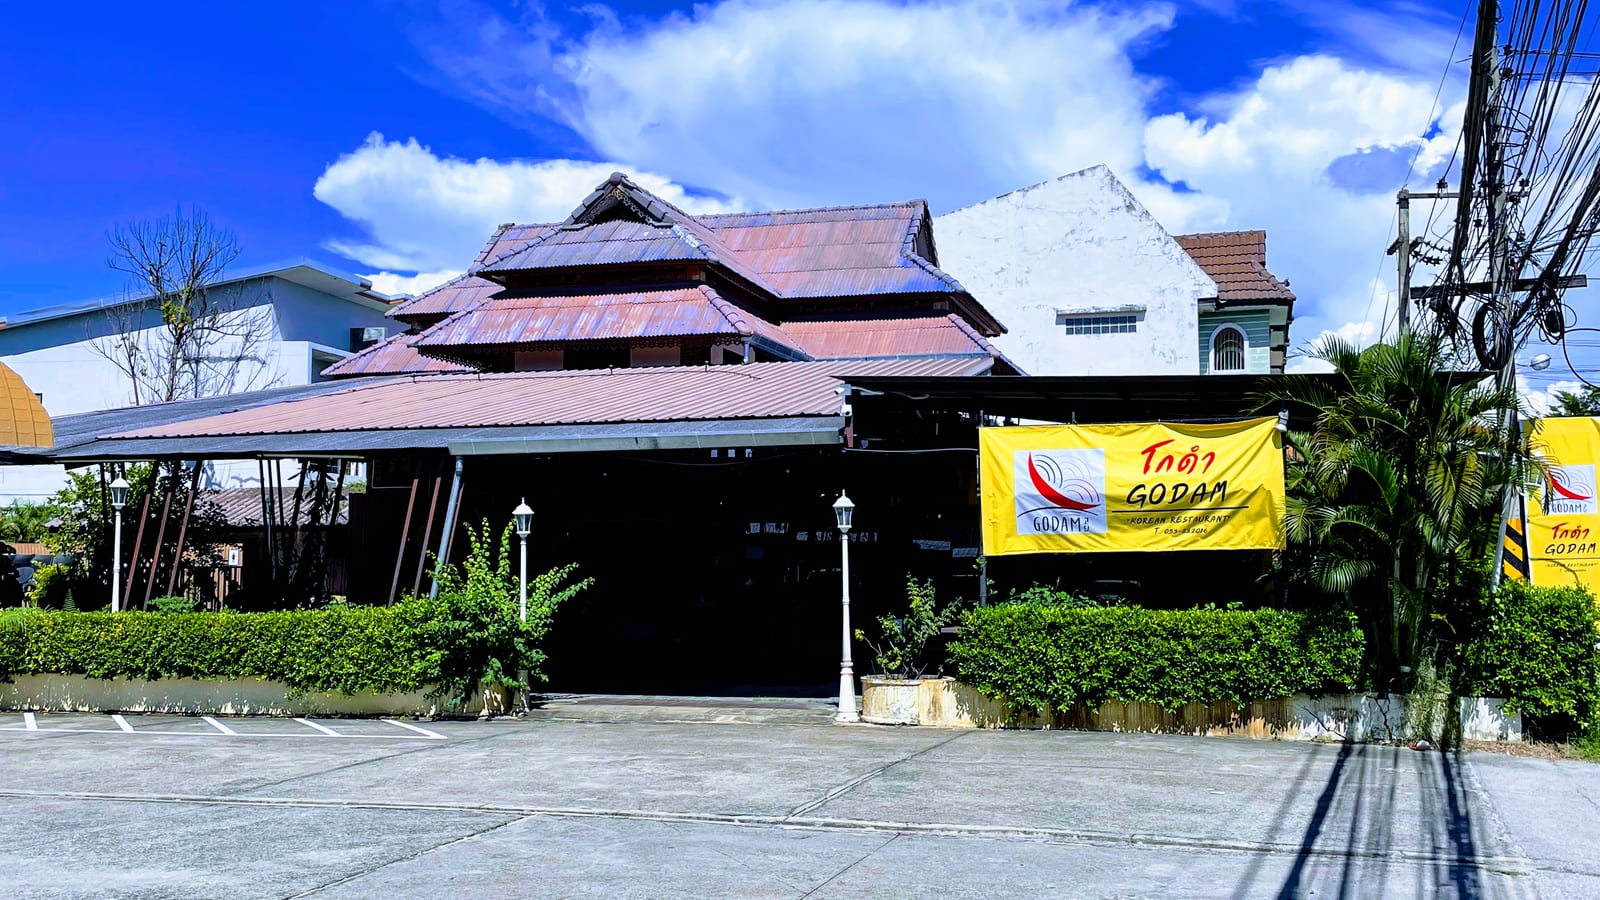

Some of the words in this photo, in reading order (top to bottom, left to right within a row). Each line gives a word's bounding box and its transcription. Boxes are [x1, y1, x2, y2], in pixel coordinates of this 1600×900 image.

[1141, 439, 1215, 475] โกดำ
[1126, 480, 1228, 508] GODAM
[1551, 503, 1582, 513] GODAM
[1033, 515, 1081, 533] GODAM
[1545, 543, 1596, 556] GODAM
